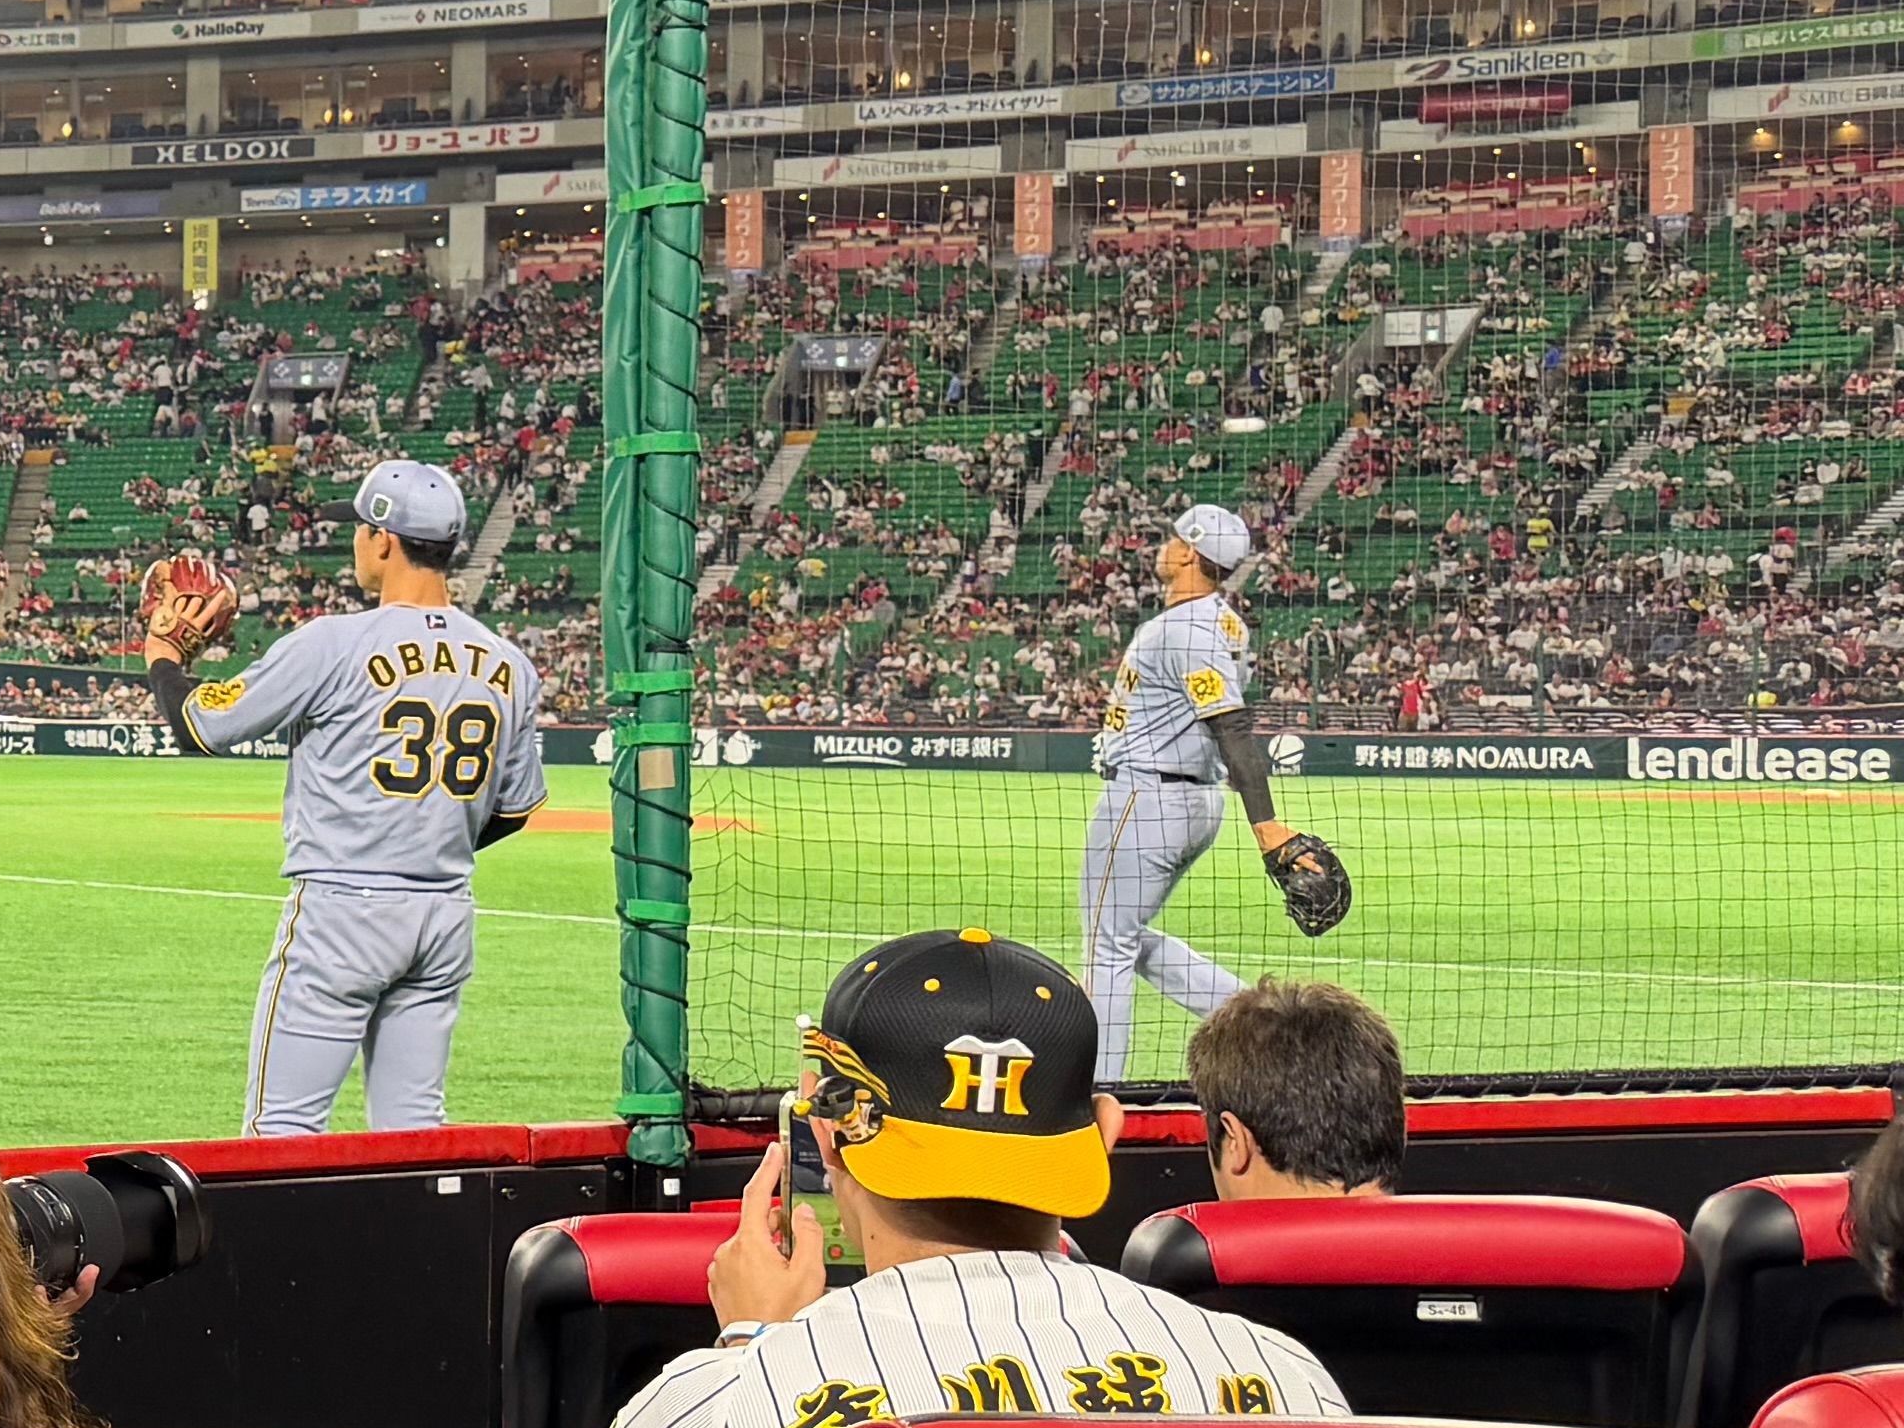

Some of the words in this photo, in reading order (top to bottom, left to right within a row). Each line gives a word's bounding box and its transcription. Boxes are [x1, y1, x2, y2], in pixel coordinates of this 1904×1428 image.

[432, 3, 528, 24] NEOMARS
[194, 21, 265, 38] HalloDay
[1456, 50, 1586, 78] Sanikleen
[307, 183, 418, 209] テラスカイ
[365, 641, 514, 701] OBATA
[369, 697, 502, 801] 38
[813, 735, 903, 756] MIZUHO
[910, 736, 1013, 759] みずほ銀行
[1456, 745, 1595, 770] NOMURA
[1626, 736, 1891, 783] lendlease
